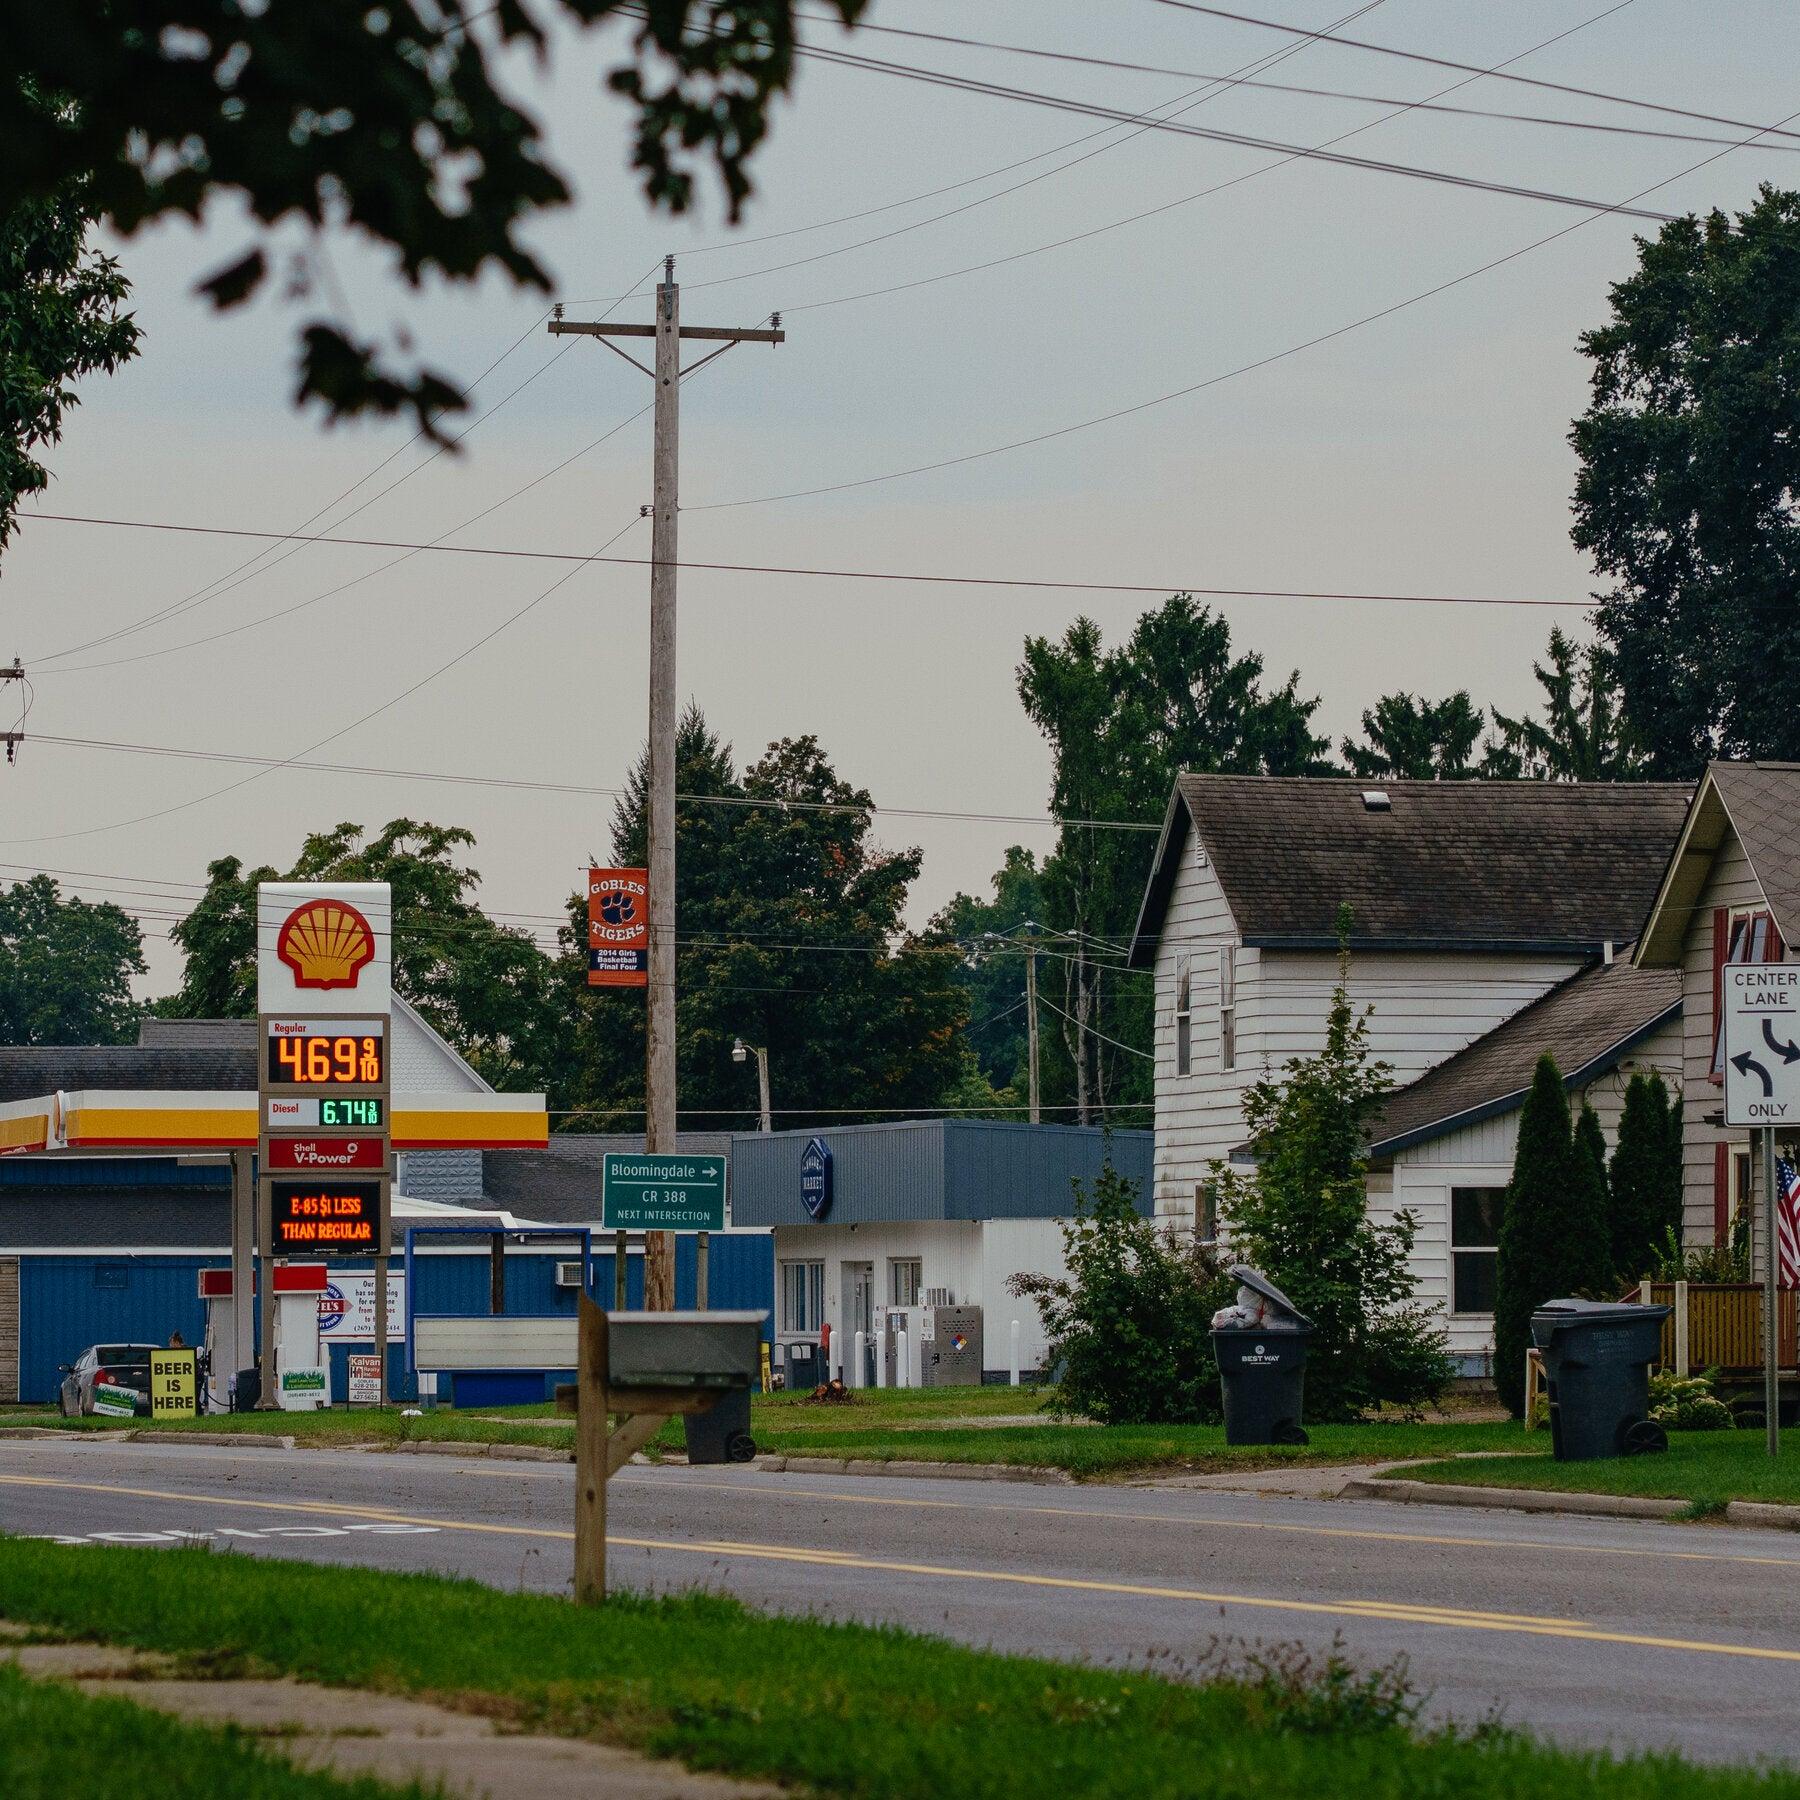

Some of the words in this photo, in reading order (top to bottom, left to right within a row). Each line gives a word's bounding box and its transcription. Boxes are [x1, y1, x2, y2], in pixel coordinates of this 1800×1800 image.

[591, 880, 645, 895] GOBLES
[592, 921, 644, 940] TIGERS
[1735, 973, 1798, 986] CENTER
[1745, 992, 1788, 1005] LANE
[274, 1023, 307, 1034] Regular
[272, 1103, 299, 1113] Diesel
[1749, 1104, 1788, 1116] ONLY
[294, 1143, 316, 1152] Shell
[294, 1152, 353, 1163] V-Power
[611, 1164, 695, 1180] Bloomingdale
[642, 1191, 658, 1202] CR
[663, 1191, 686, 1203] 388
[291, 1198, 318, 1214] E-85
[335, 1198, 361, 1214] LESS
[617, 1210, 640, 1219] NEXT
[644, 1210, 710, 1221] INTERSECTION
[282, 1222, 316, 1239] THAN
[318, 1222, 371, 1239] REGULAR
[351, 1357, 380, 1366] Kalvan
[154, 1362, 193, 1375] BEER
[166, 1379, 181, 1392] IS
[154, 1396, 194, 1409] HERE
